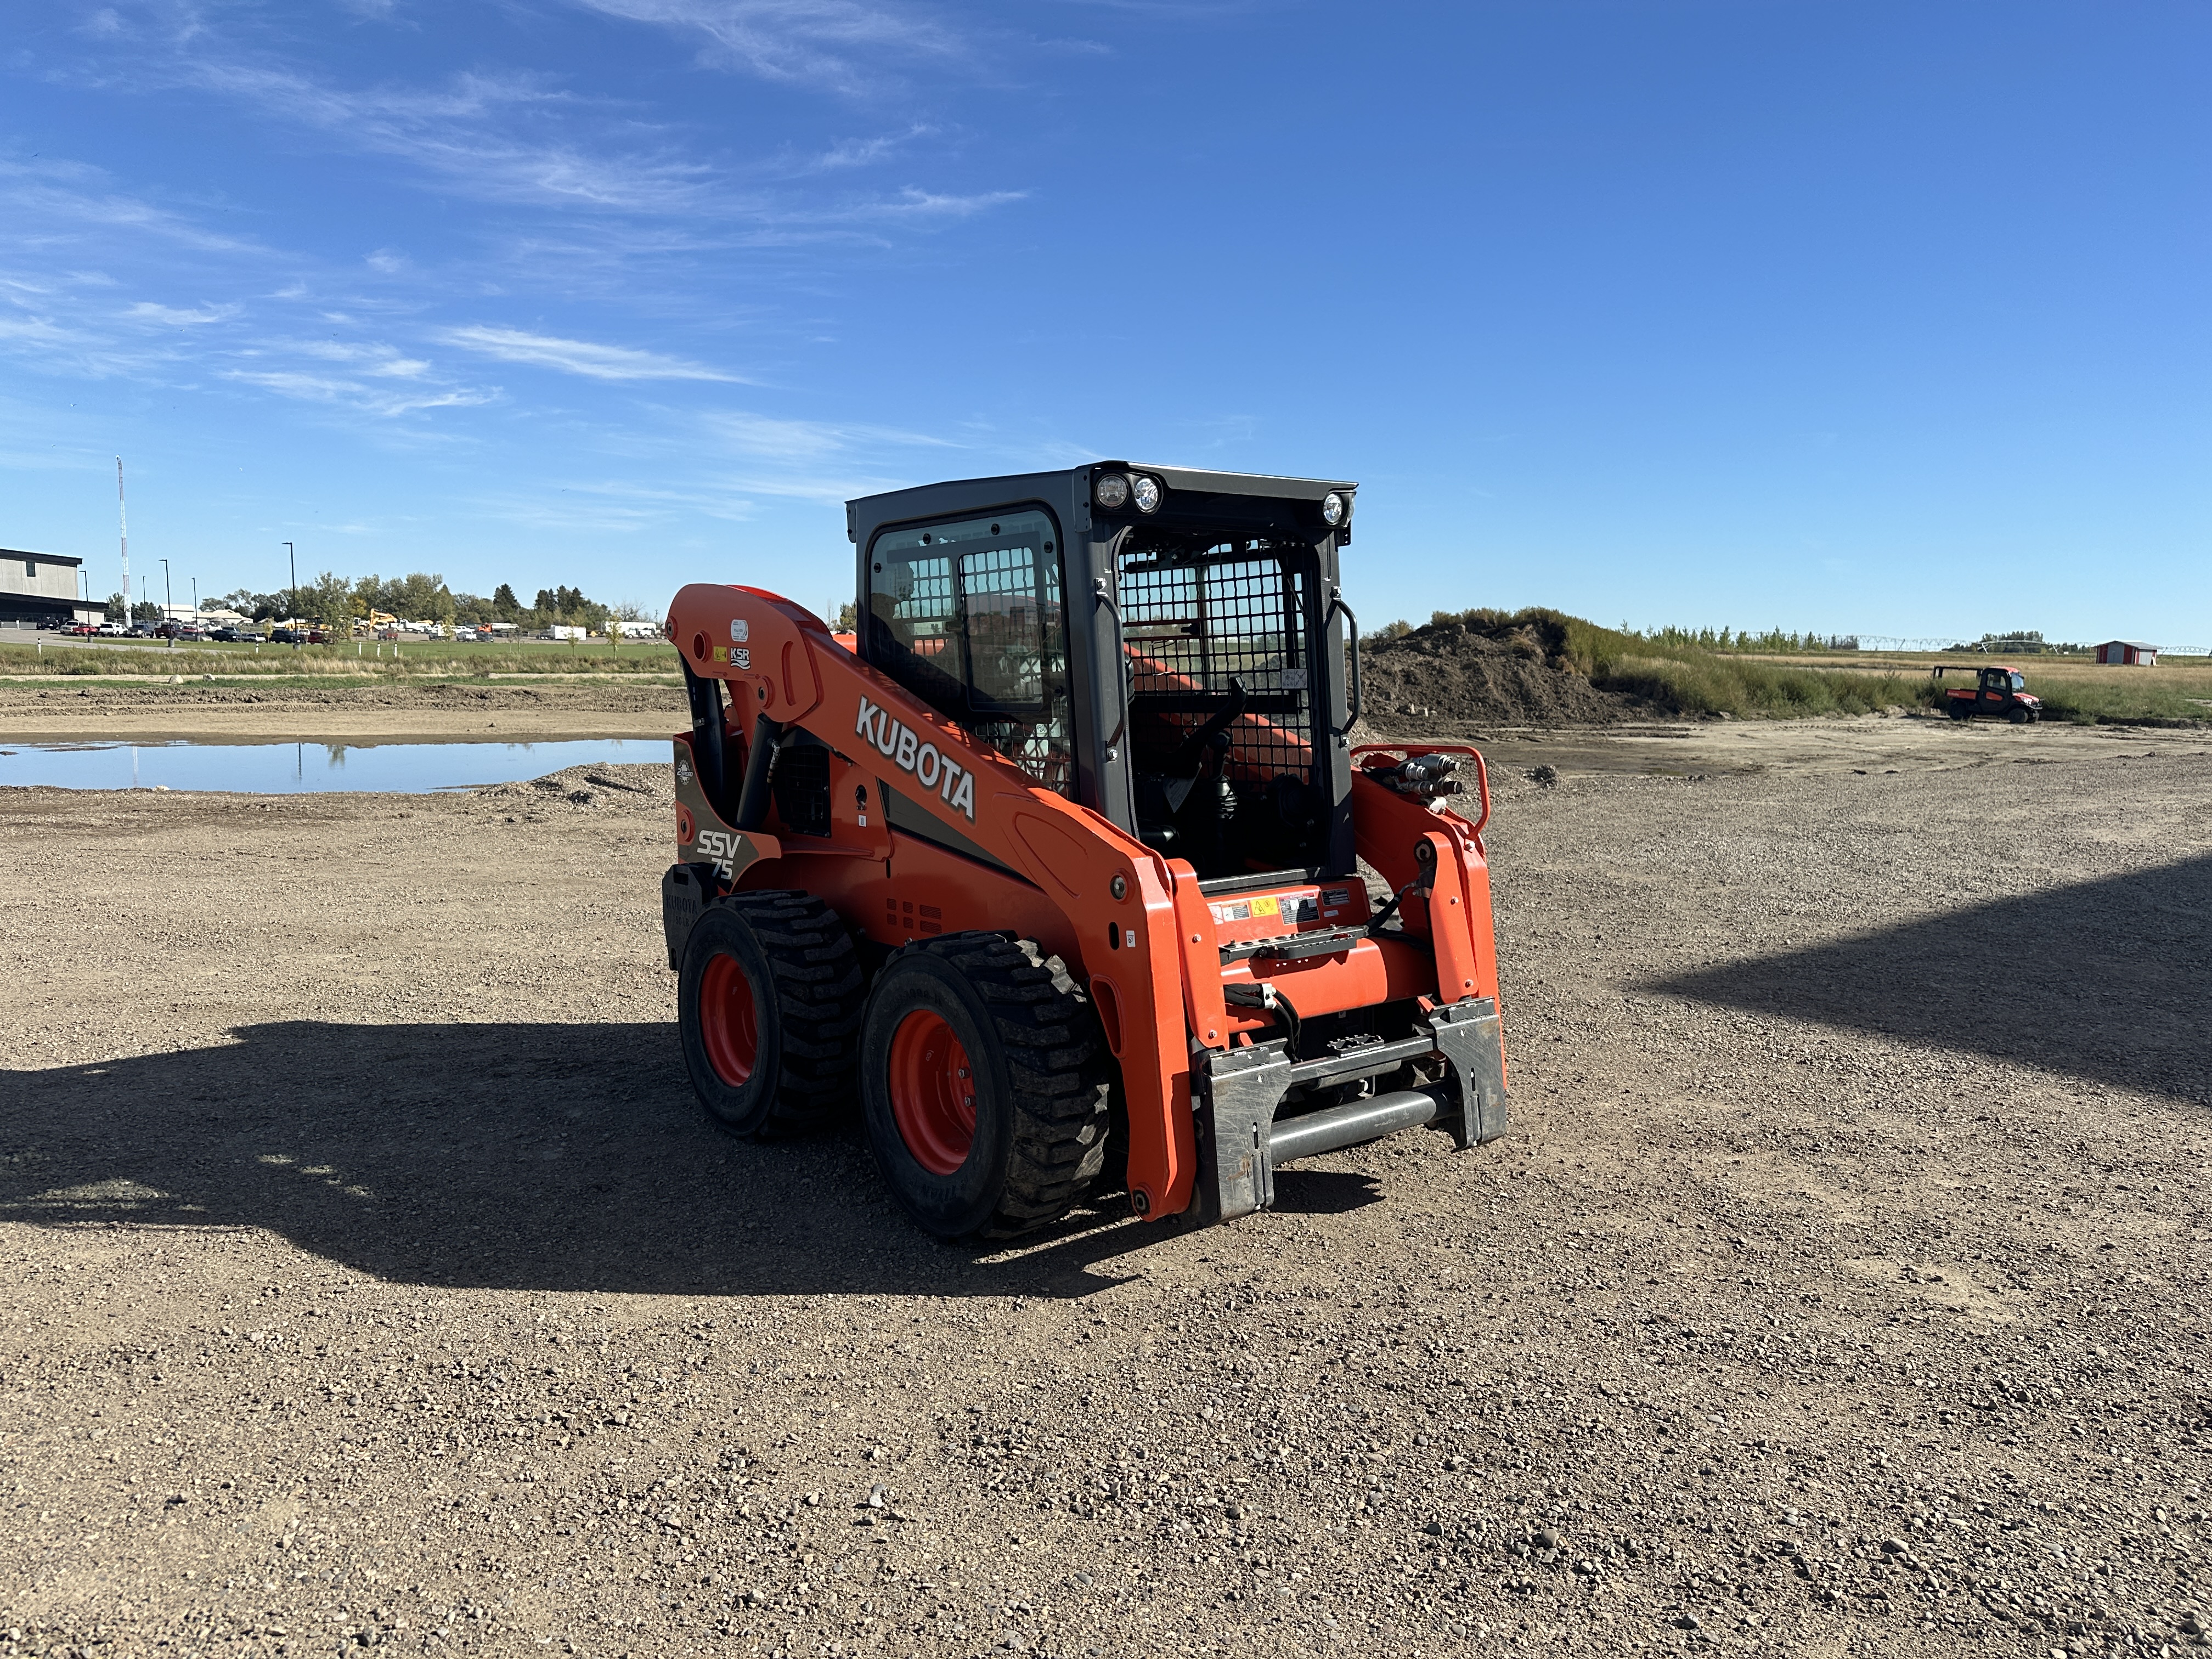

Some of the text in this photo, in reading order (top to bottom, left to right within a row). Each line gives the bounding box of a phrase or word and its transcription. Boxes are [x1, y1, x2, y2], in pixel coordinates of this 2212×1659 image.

[730, 647, 749, 661] KSR
[856, 695, 973, 820] KUBOTA
[697, 830, 741, 859] SSV
[711, 857, 733, 880] 75
[665, 894, 698, 915] KUBOTA
